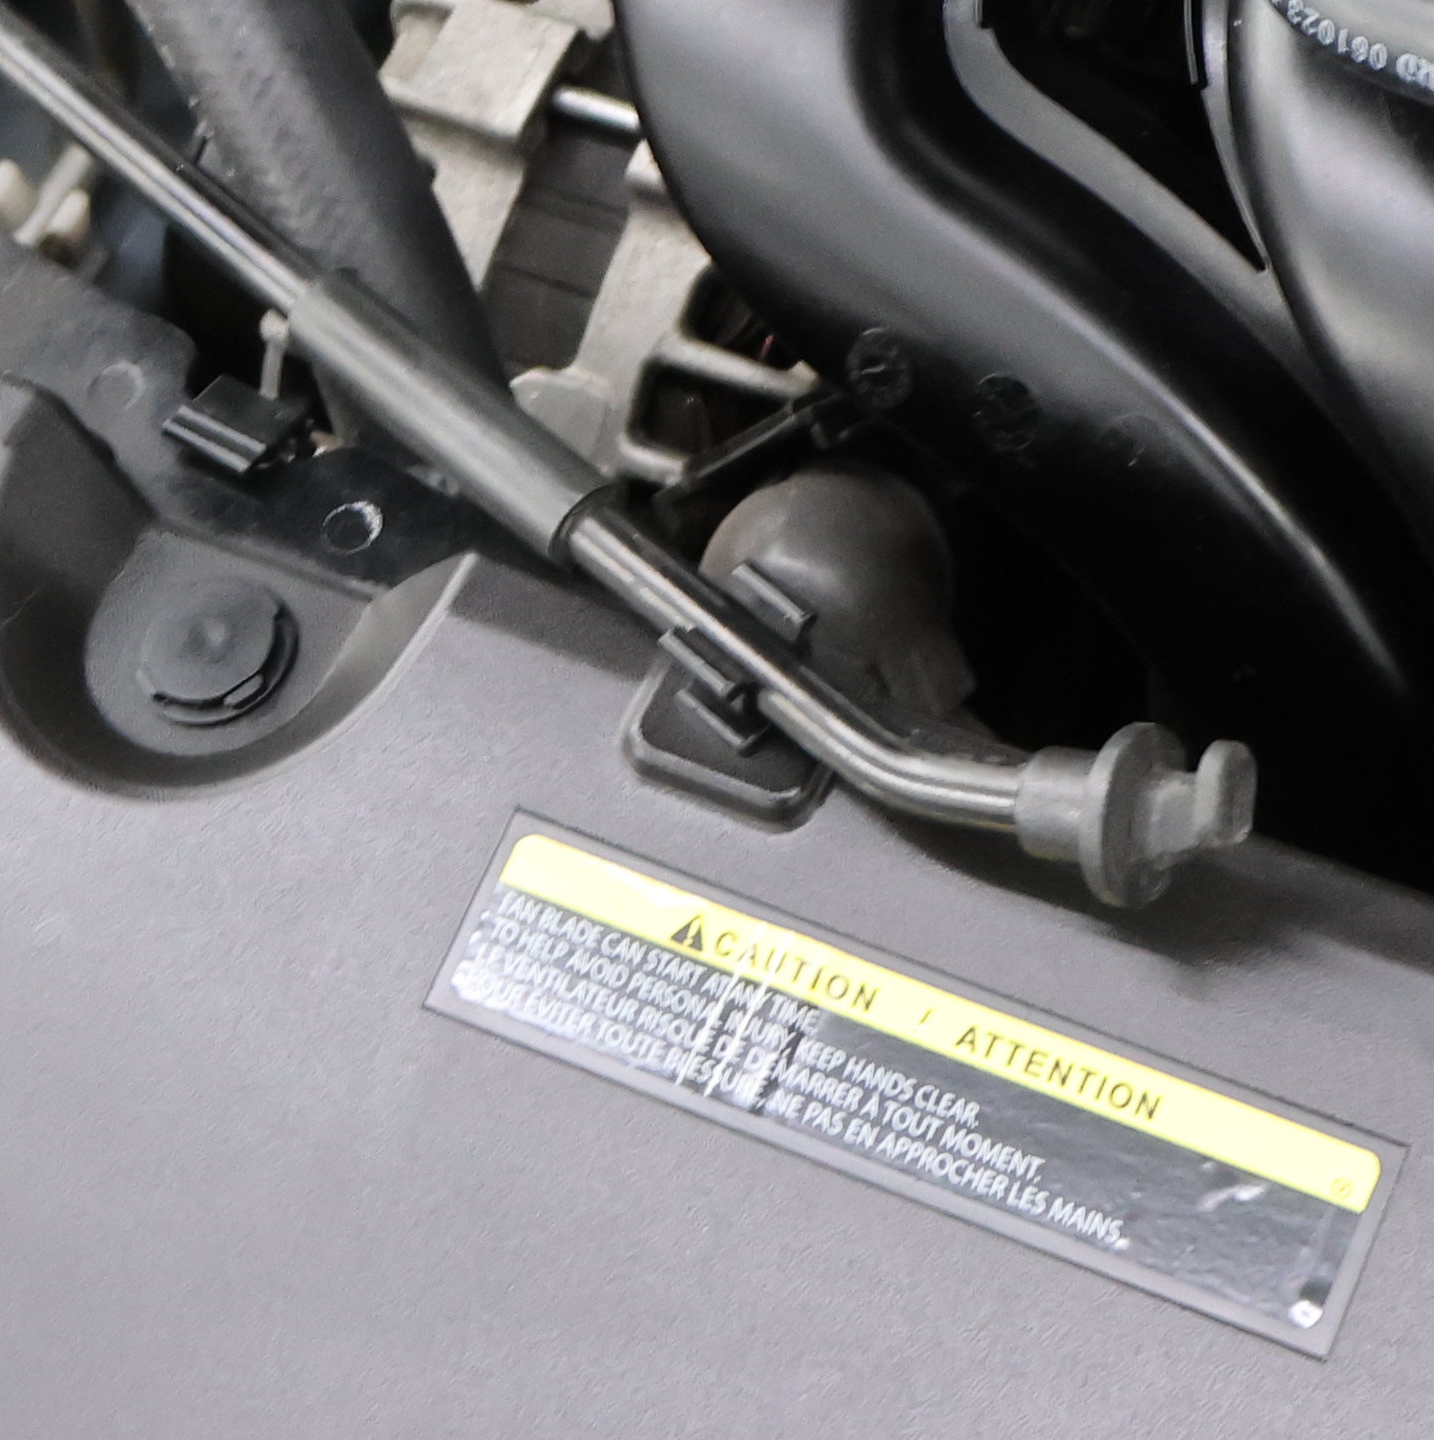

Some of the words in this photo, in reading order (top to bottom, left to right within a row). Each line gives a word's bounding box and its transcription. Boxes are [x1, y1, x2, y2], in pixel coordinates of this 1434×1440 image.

[516, 926, 569, 965] HELP
[564, 945, 630, 990] AVOID
[794, 1037, 846, 1076] KEEP
[842, 1055, 918, 1104] HANDS
[599, 929, 646, 966] CAN
[642, 947, 704, 990] START
[711, 927, 881, 1014] CAUTION
[955, 1021, 1163, 1123] ATTENTION
[768, 1088, 805, 1120] NE
[801, 1102, 846, 1137] PAS
[843, 1118, 879, 1151] EN
[874, 1129, 1011, 1202] APPROCHER
[1006, 1180, 1050, 1217] LES
[880, 1100, 944, 1143] TOUT
